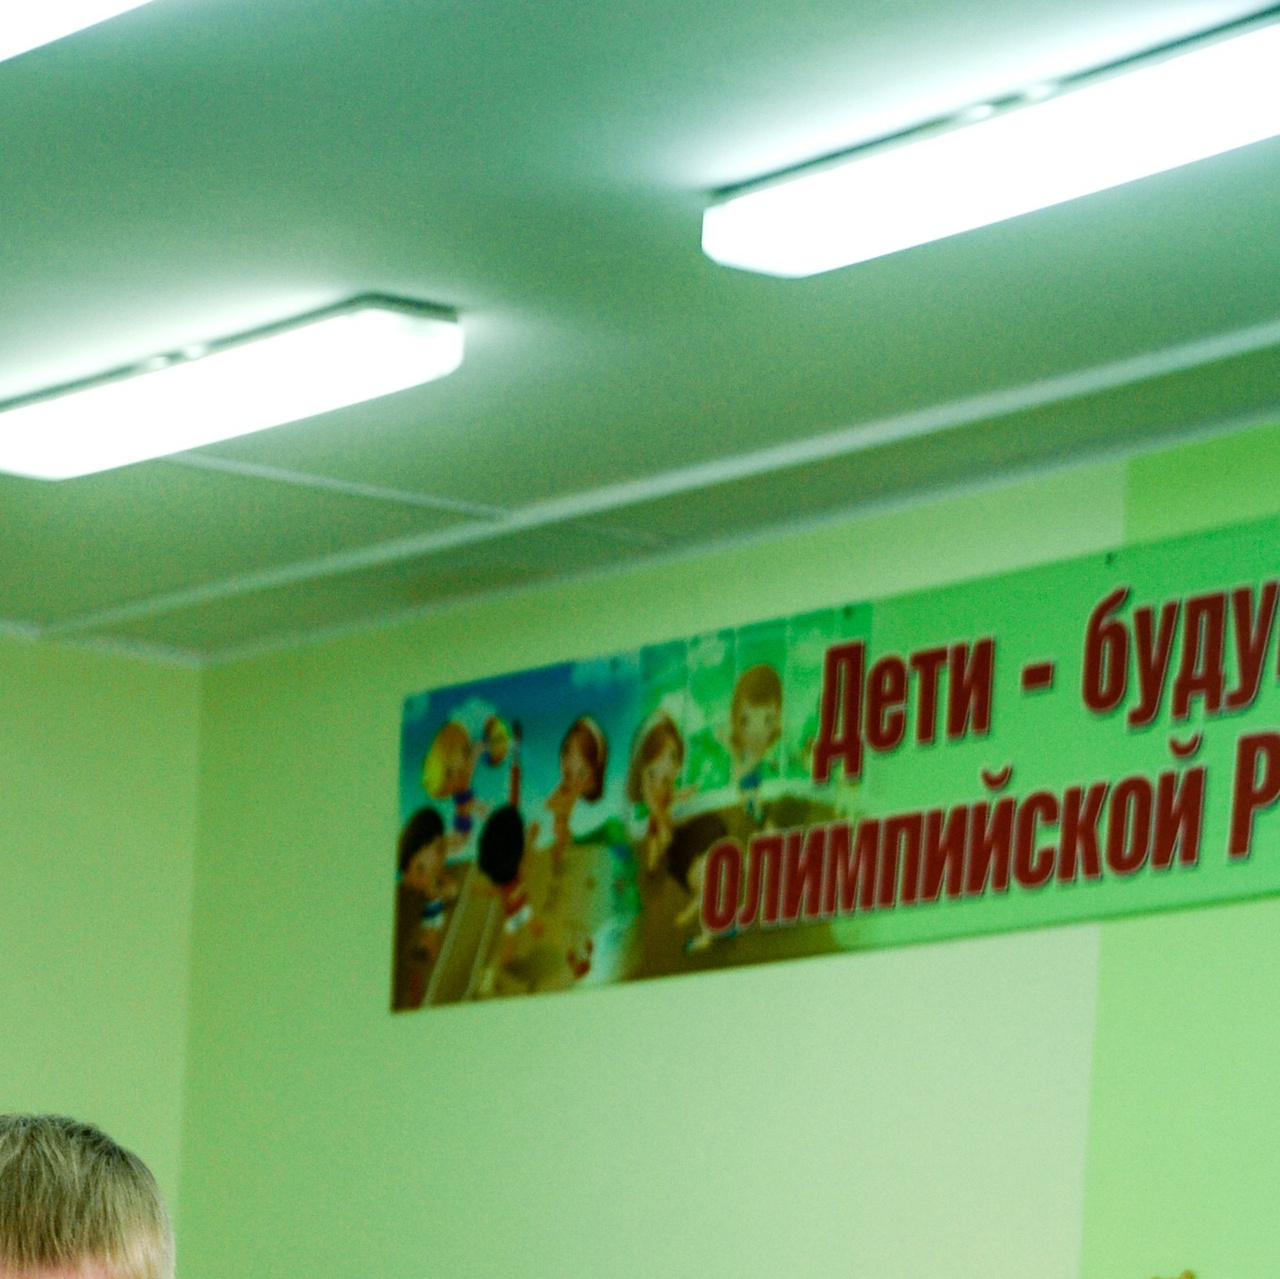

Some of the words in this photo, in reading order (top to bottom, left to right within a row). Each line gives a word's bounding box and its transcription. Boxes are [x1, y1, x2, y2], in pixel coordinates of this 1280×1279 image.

[812, 637, 995, 783] Дети
[1022, 661, 1054, 690] -
[1081, 581, 1280, 727] буду
[701, 735, 1205, 934] олимпийской
